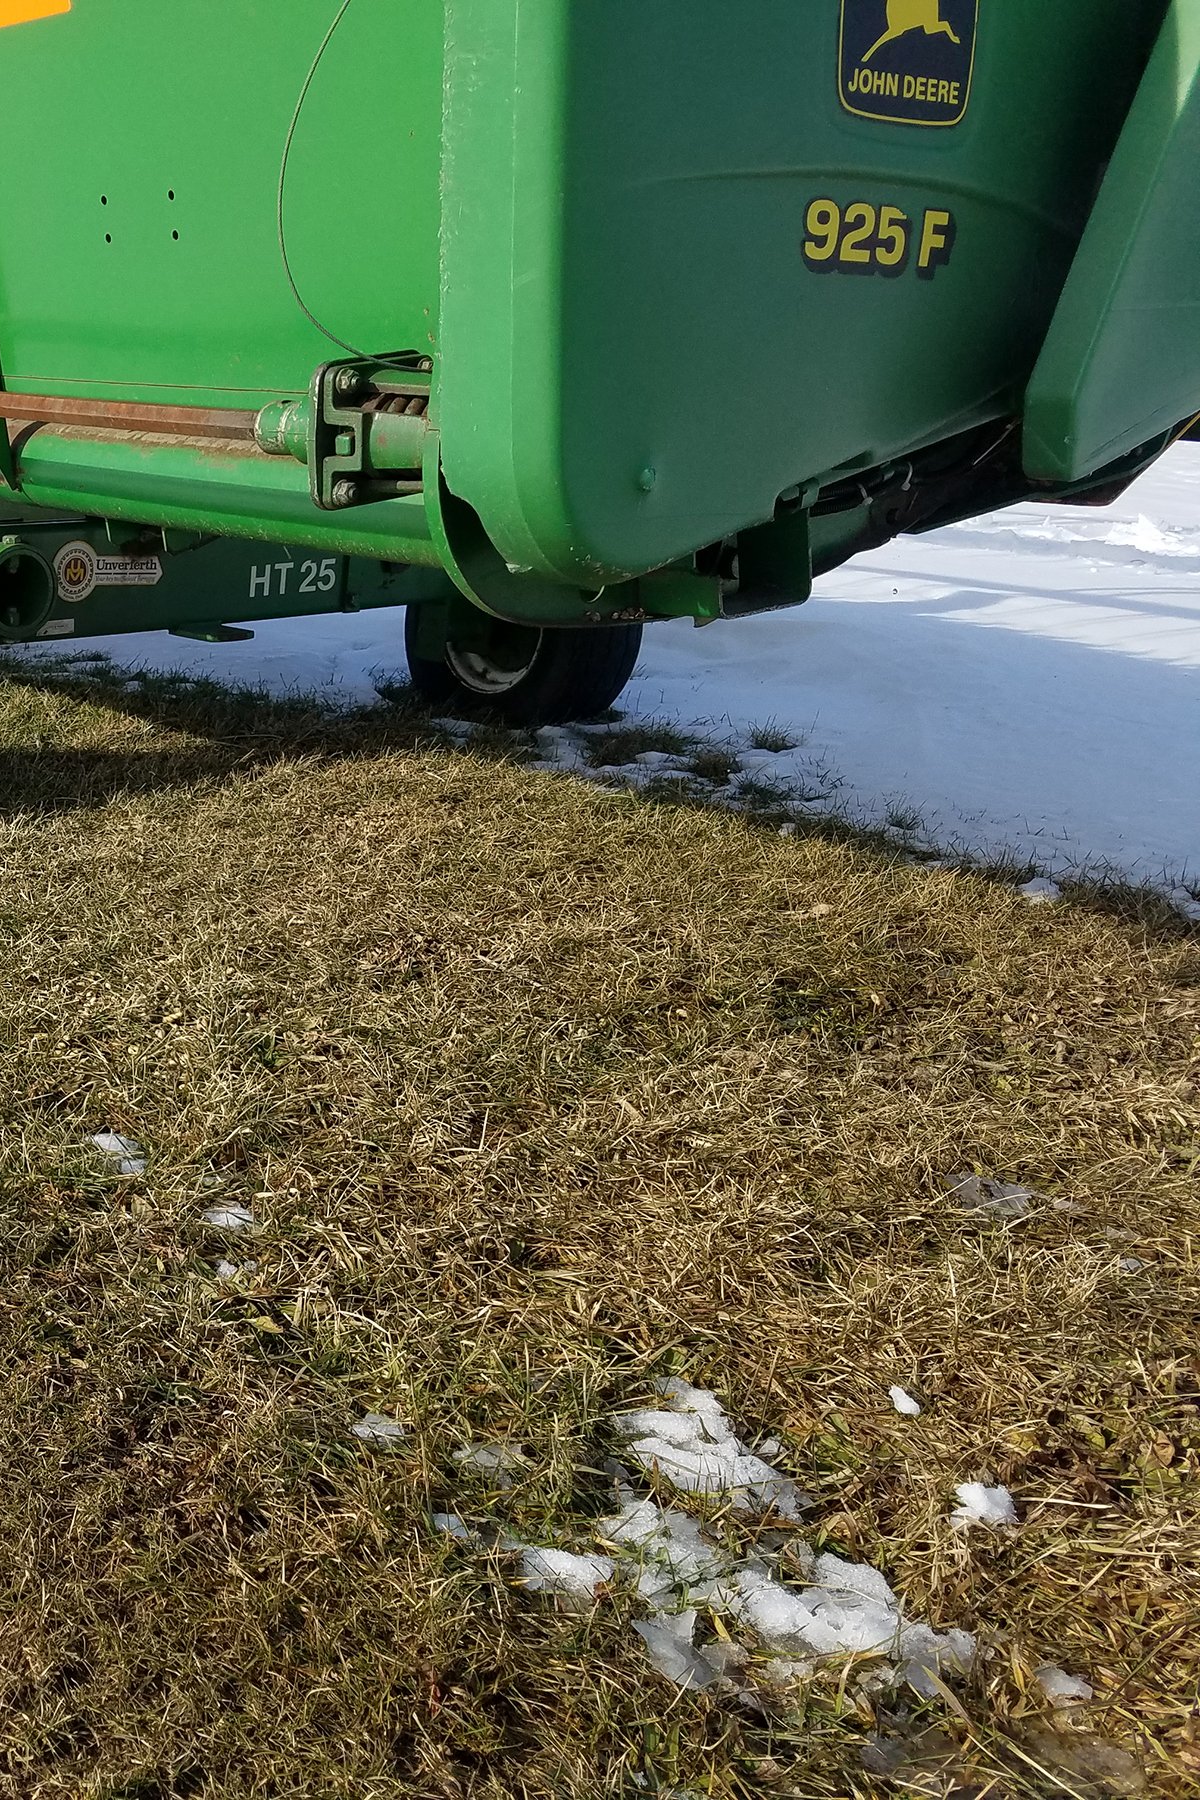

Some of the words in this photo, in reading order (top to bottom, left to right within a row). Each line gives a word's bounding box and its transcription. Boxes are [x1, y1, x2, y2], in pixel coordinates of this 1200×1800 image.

[848, 68, 899, 97] JOHN
[903, 75, 960, 105] DEERE
[804, 199, 908, 267] 925
[918, 210, 950, 268] F
[96, 559, 157, 571] Unverferth
[249, 561, 294, 598] HT
[299, 558, 336, 593] 25
